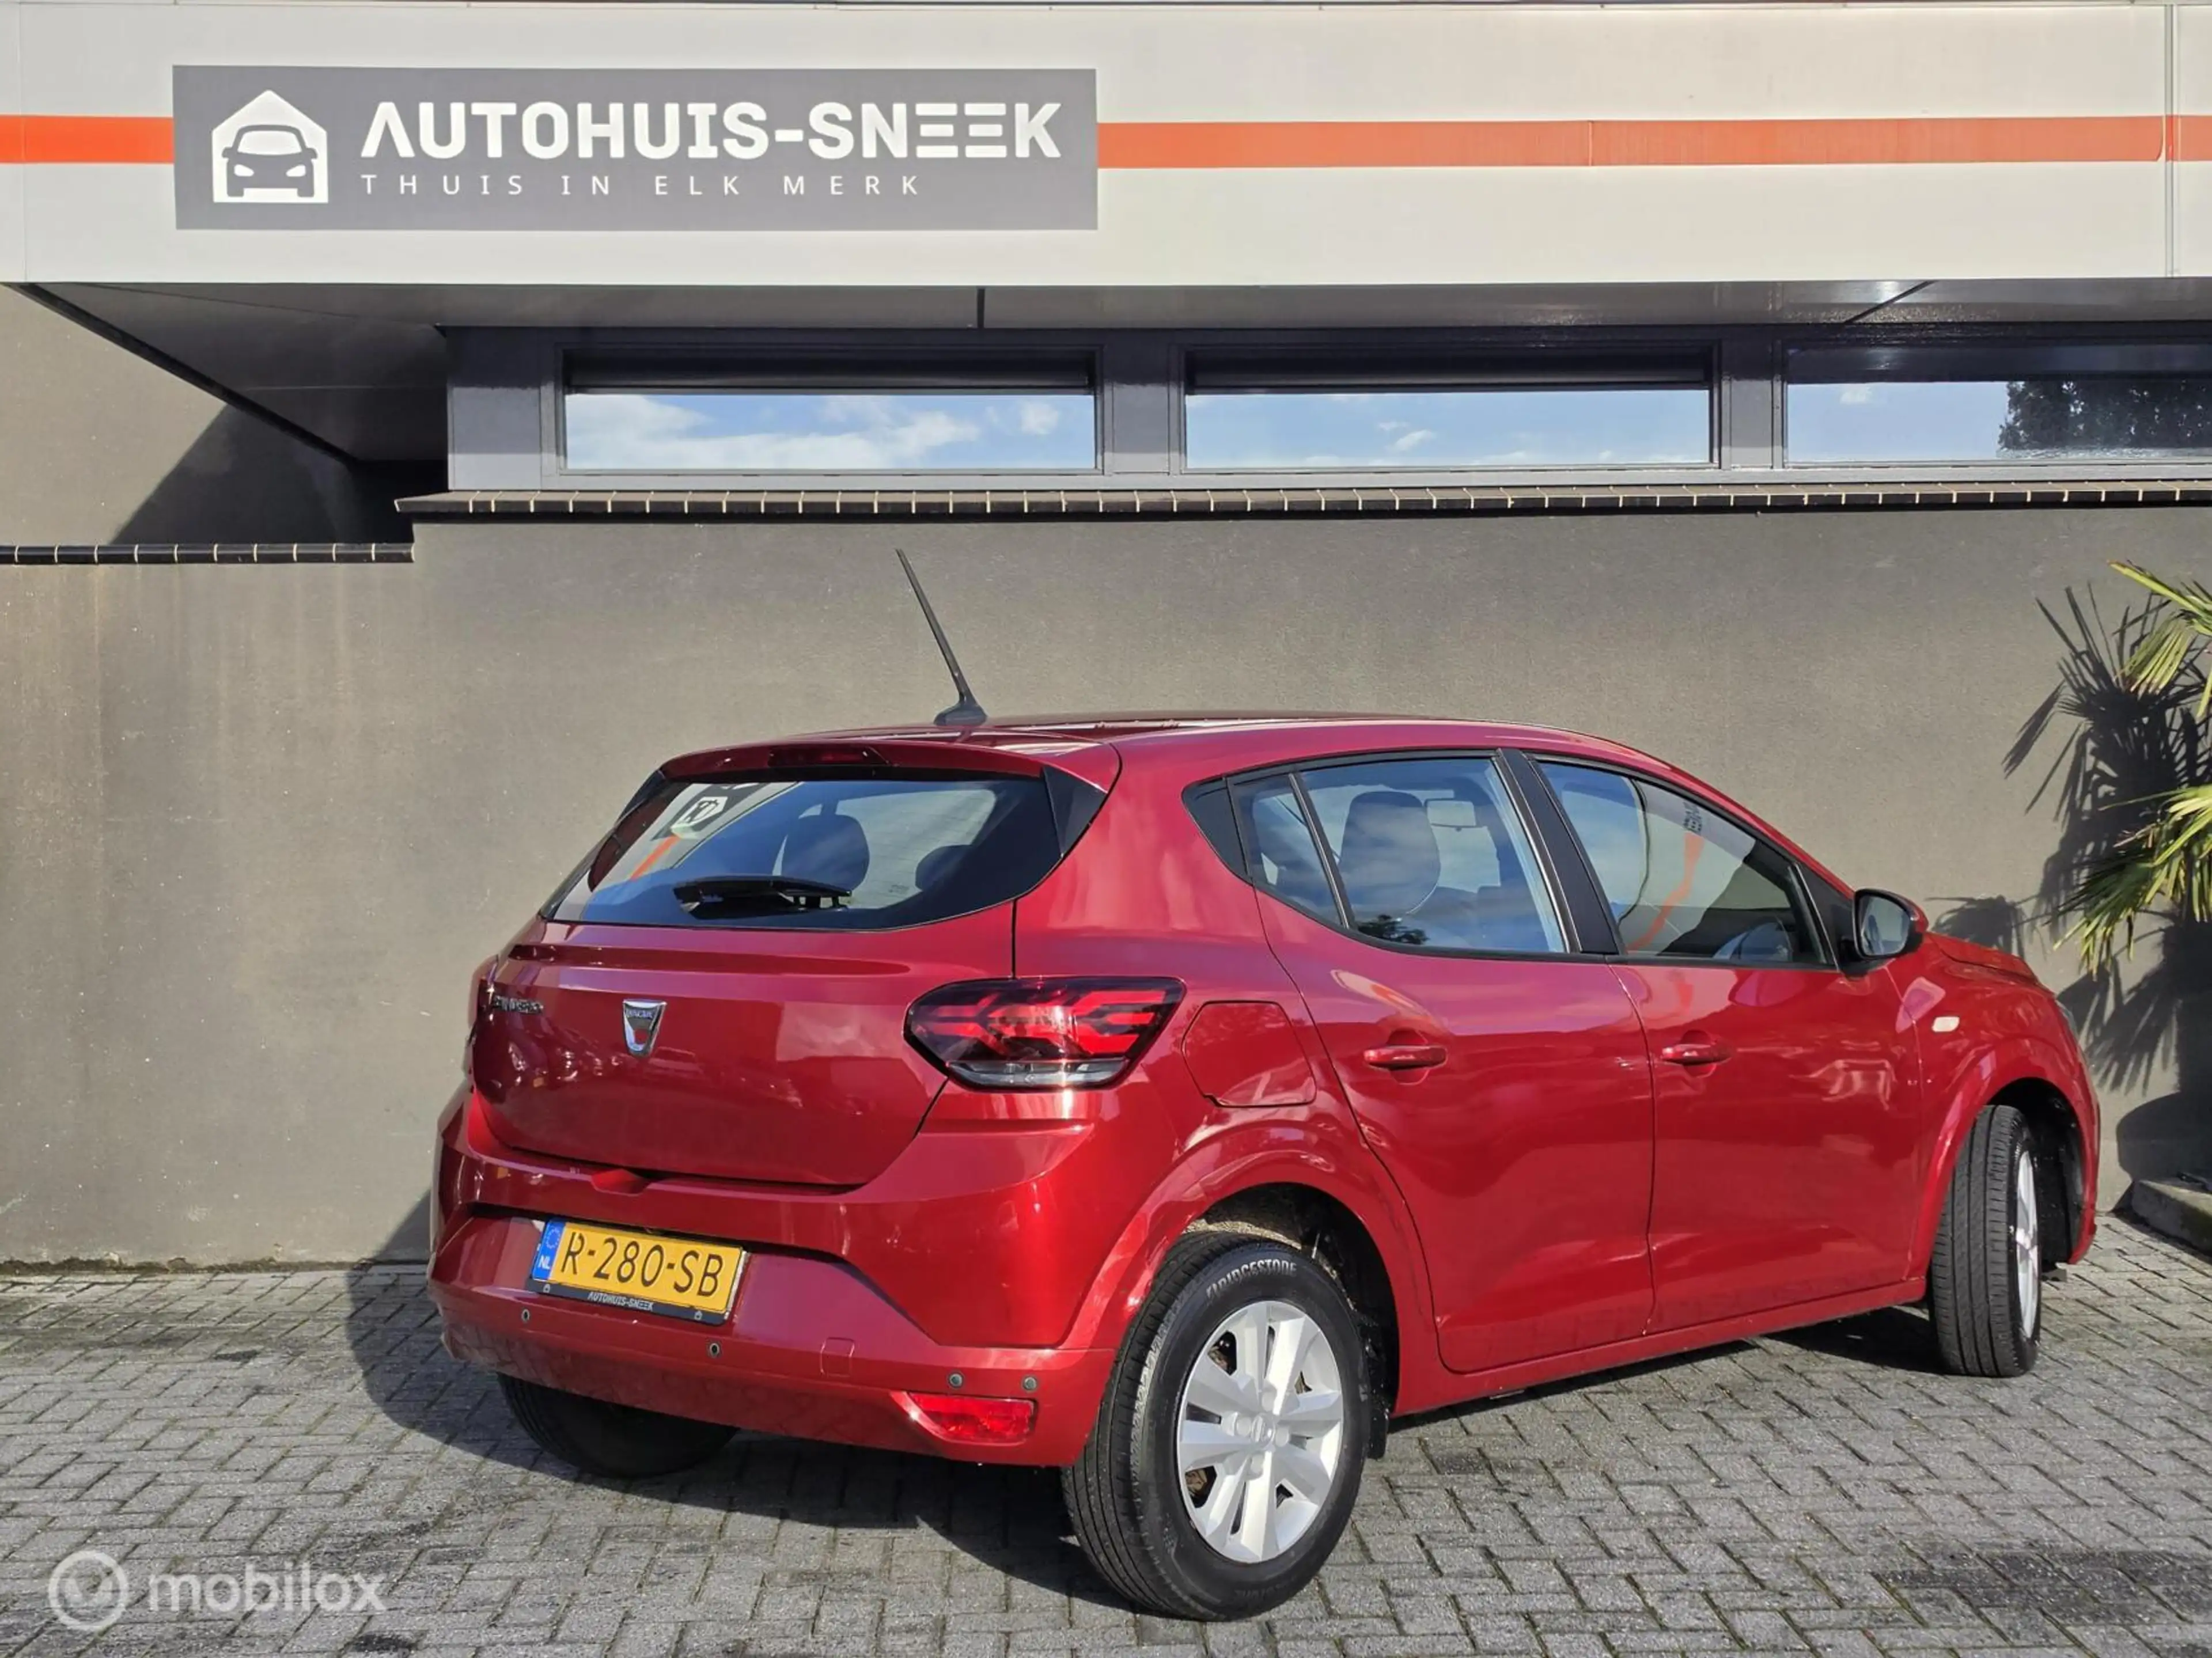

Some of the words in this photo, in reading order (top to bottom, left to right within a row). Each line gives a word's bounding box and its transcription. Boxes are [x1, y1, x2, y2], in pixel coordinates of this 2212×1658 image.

[361, 101, 1061, 160] AUTOHUIS-SNEEK
[361, 174, 522, 195] THUIS
[561, 175, 609, 195] IN
[655, 176, 738, 195] ELK
[784, 176, 917, 195] MERK
[538, 1255, 551, 1269] NL
[560, 1231, 724, 1297] R-280-SB
